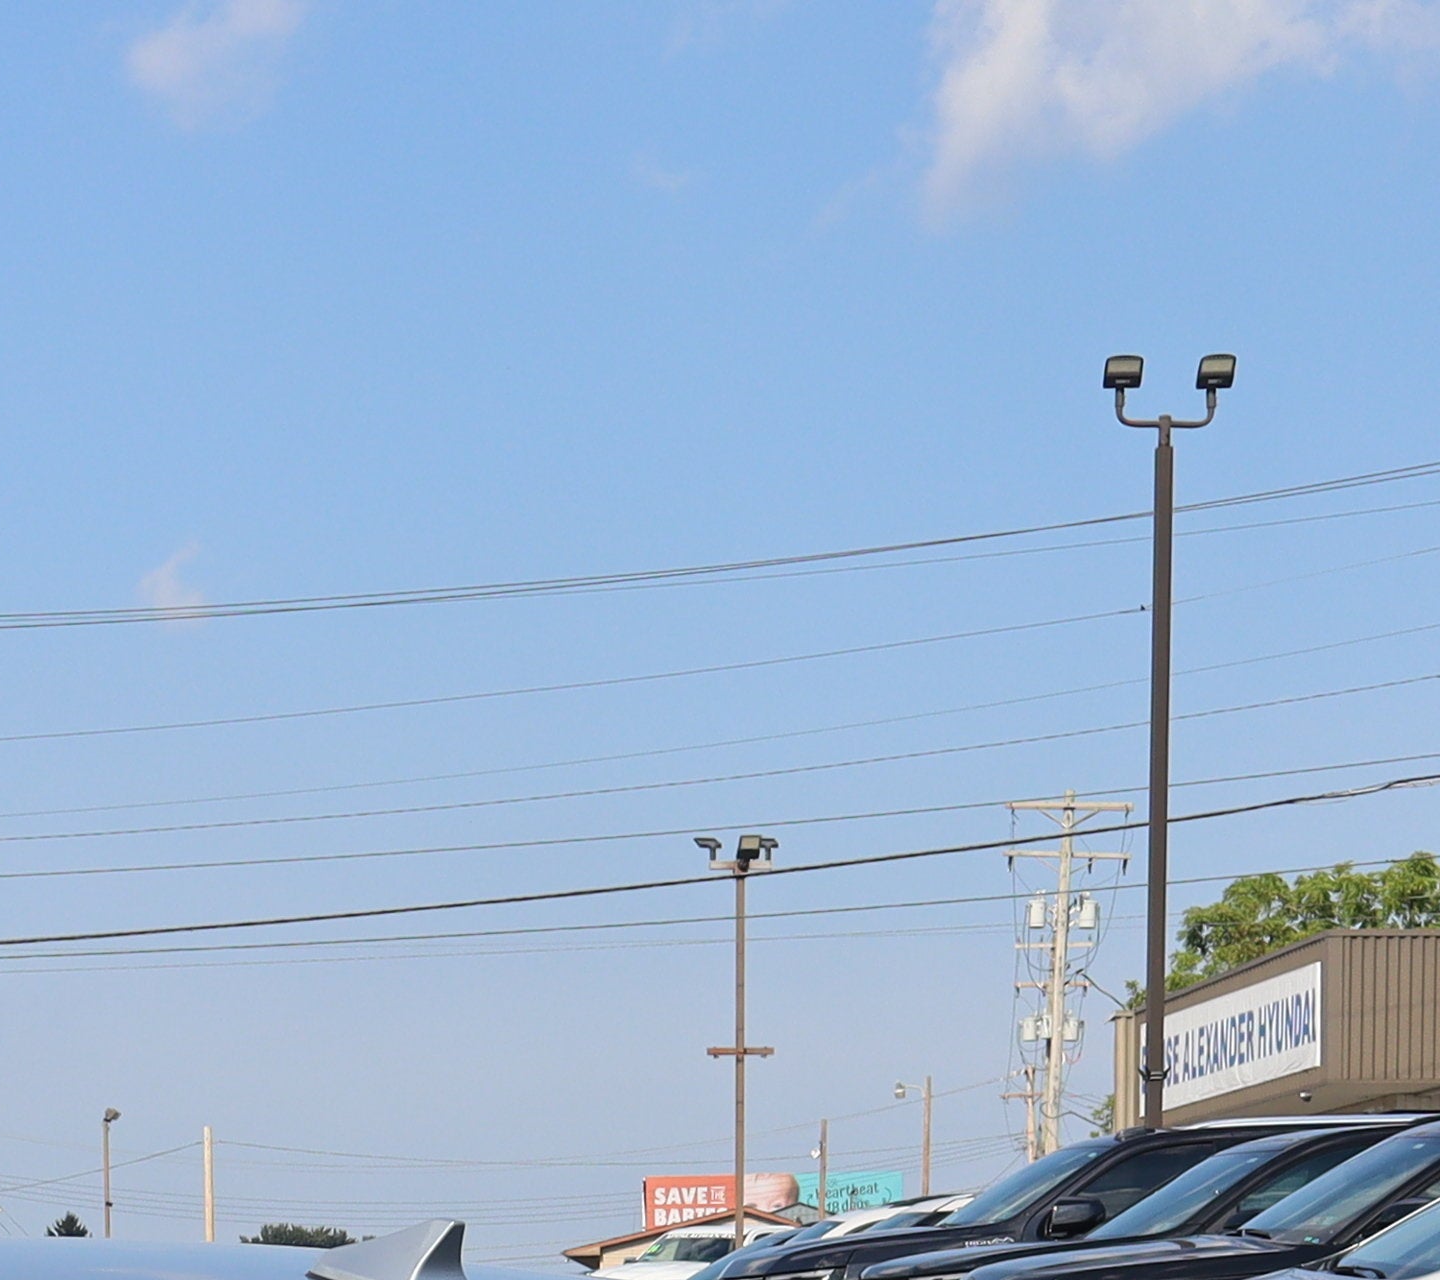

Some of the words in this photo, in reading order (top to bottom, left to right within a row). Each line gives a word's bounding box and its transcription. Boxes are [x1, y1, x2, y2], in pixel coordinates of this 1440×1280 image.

[1183, 1010, 1255, 1083] ALEXANDER
[1258, 987, 1316, 1060] HYUNDAI
[654, 1186, 708, 1205] SAVE
[710, 1189, 726, 1201] THE
